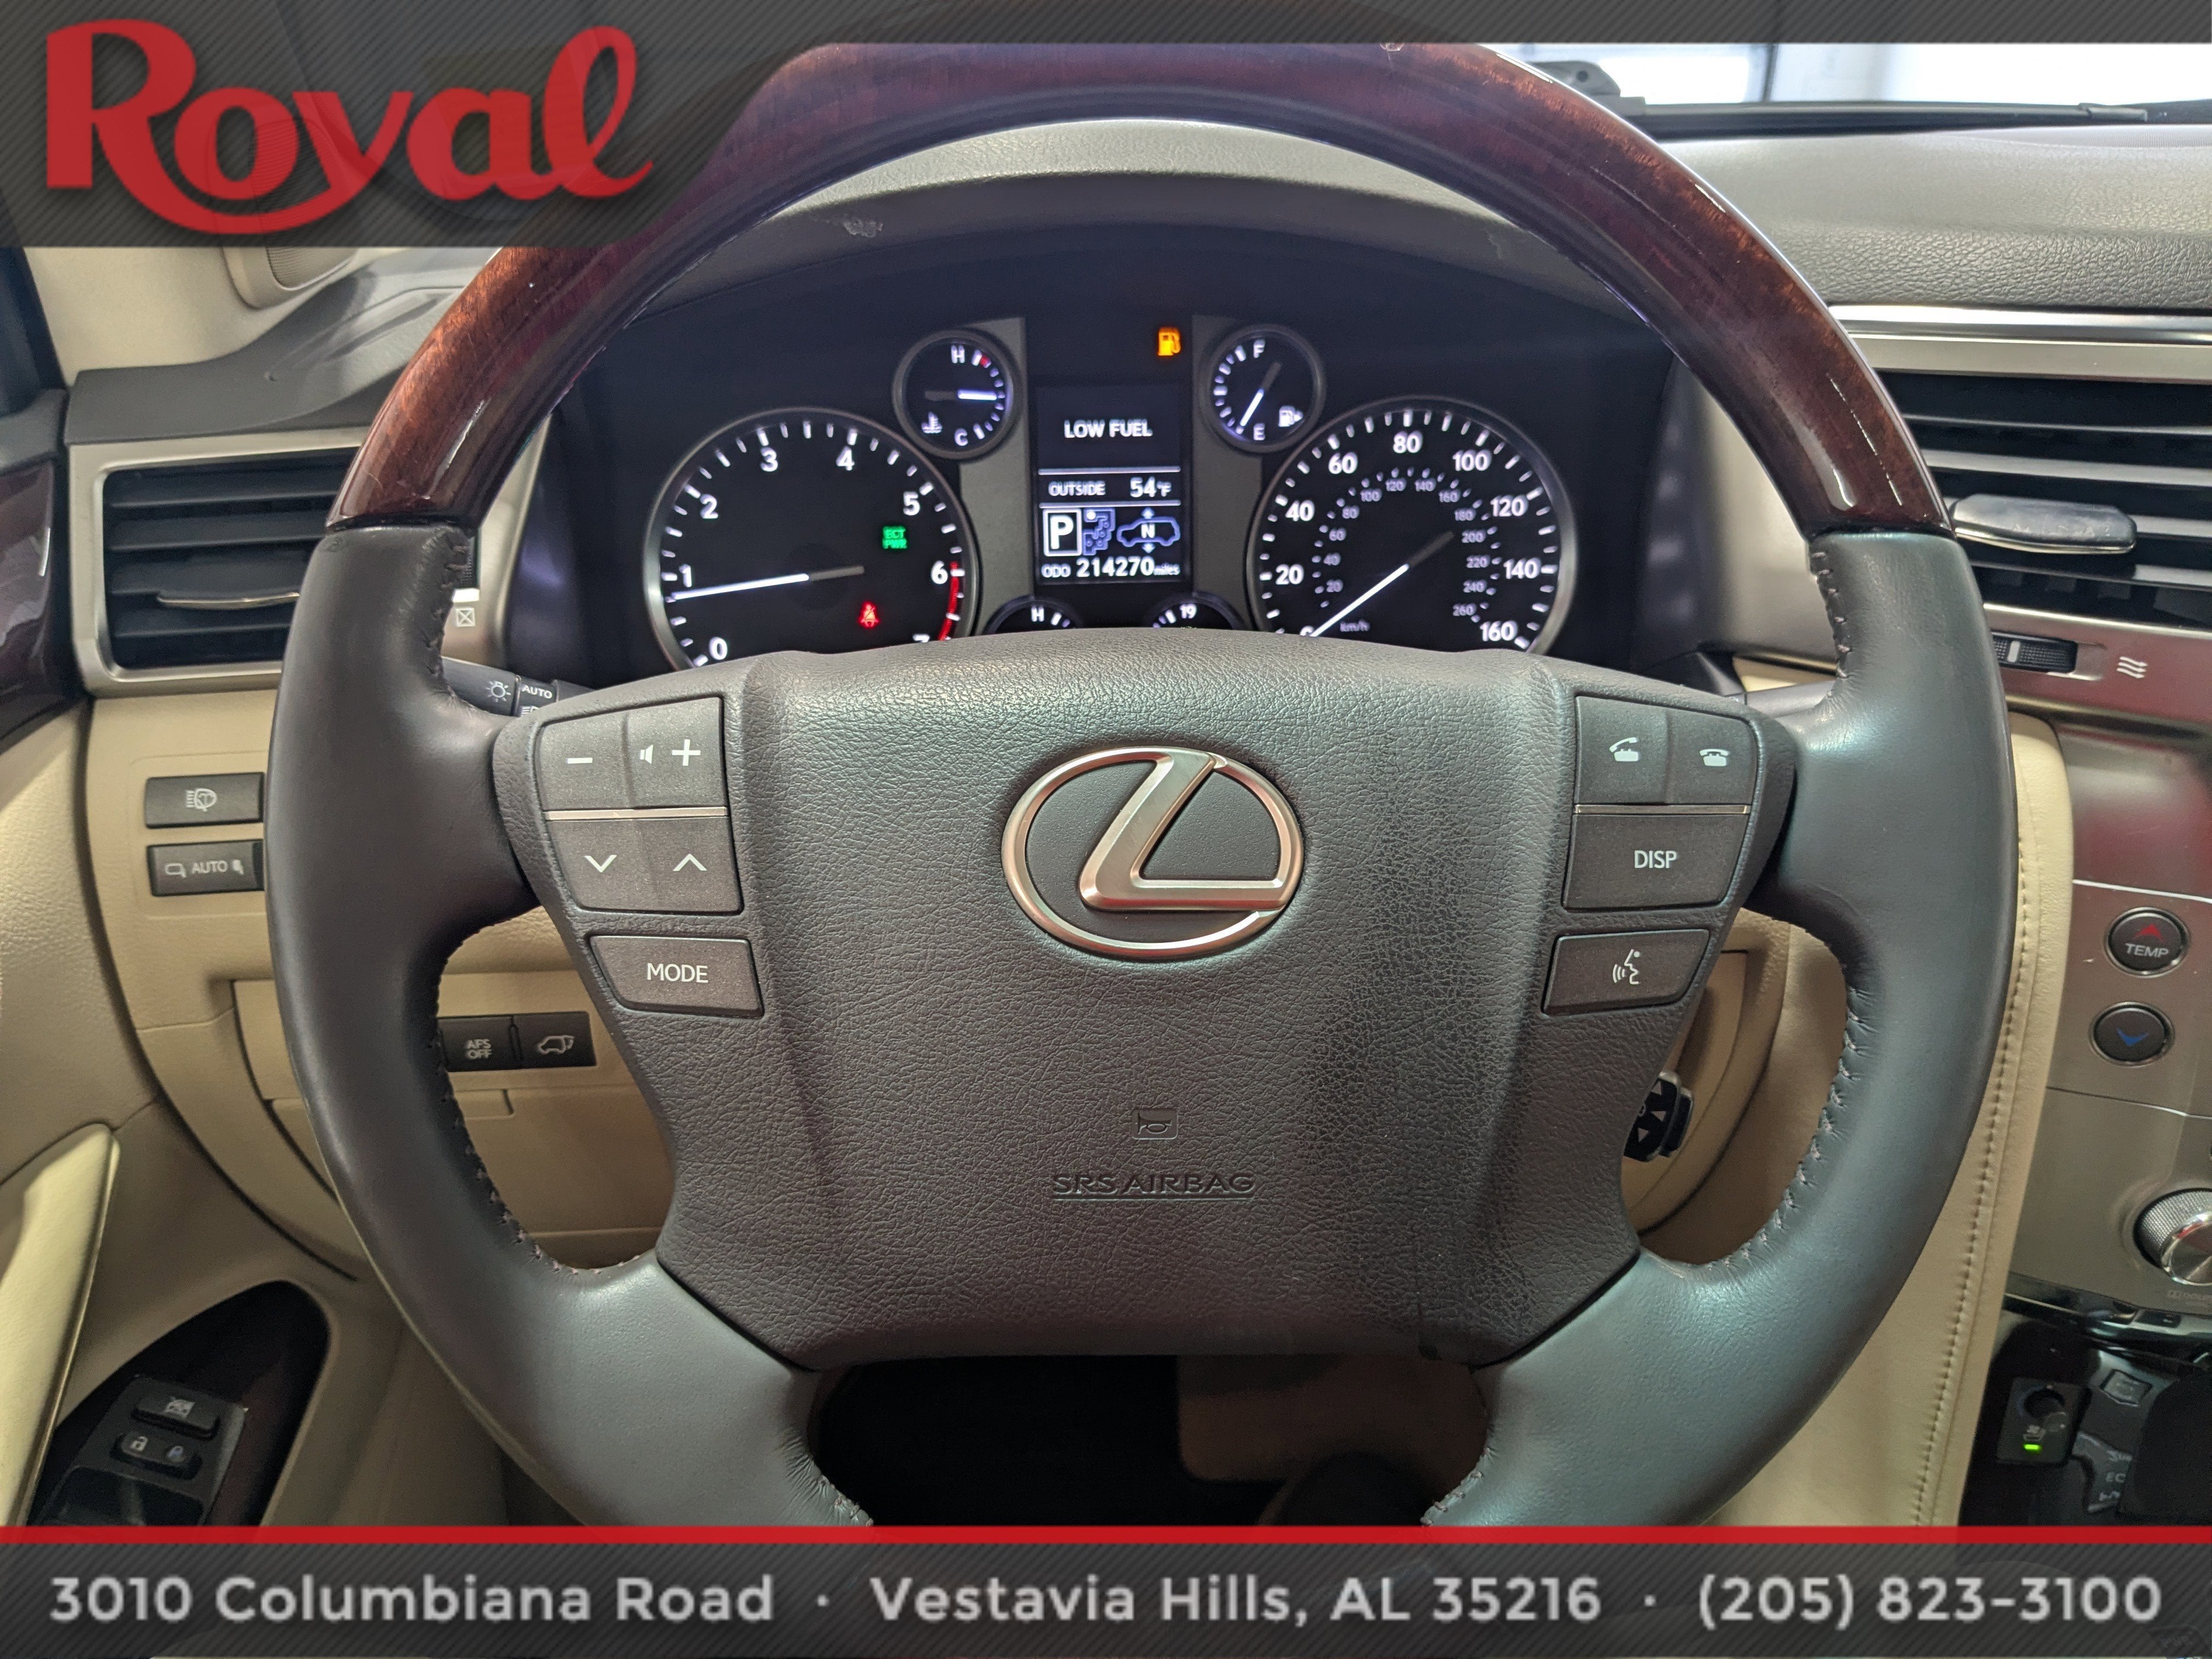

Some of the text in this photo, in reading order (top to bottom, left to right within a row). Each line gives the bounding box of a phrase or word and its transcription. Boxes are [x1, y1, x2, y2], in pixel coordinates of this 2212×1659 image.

[951, 345, 965, 363] H
[1253, 340, 1265, 358] F
[955, 428, 968, 446] C
[1064, 419, 1153, 438] LOW FUEL
[1253, 423, 1265, 441] E
[1393, 431, 1423, 453] 80
[760, 447, 778, 472] 3
[836, 446, 855, 471] 4
[1328, 452, 1358, 474] 60
[1452, 450, 1491, 471] 100
[1048, 481, 1105, 496] OUTSIDE
[1385, 478, 1406, 492] 120
[1414, 478, 1436, 492] 140
[903, 491, 920, 516] 5
[1360, 489, 1382, 502] 100
[1438, 489, 1460, 503] 160
[701, 494, 719, 518] 2
[1285, 500, 1314, 521] 40
[1342, 506, 1359, 519] 80
[1491, 495, 1526, 517] 120
[1454, 510, 1475, 521] 180
[1049, 515, 1074, 549] P
[1141, 522, 1156, 539] N
[1329, 528, 1346, 541] 60
[1462, 530, 1485, 543] 200
[1041, 563, 1071, 578] ODO
[1075, 554, 1154, 577] 214270
[1323, 554, 1340, 566] 40
[1466, 555, 1490, 568] 220
[1503, 557, 1541, 579] 140
[679, 564, 692, 588] 1
[931, 561, 948, 584] 6
[1276, 564, 1304, 585] 20
[1327, 580, 1343, 592] 20
[1463, 580, 1486, 592] 240
[1031, 606, 1044, 622] H
[1180, 602, 1197, 619] 19
[1453, 603, 1475, 616] 260
[1480, 620, 1517, 641] 160
[708, 637, 727, 660] 0
[522, 684, 552, 699] AUTO
[192, 860, 228, 874] AUTO
[1635, 850, 1677, 868] DISP
[2124, 943, 2170, 958] TEMP
[647, 963, 708, 983] MODE
[466, 1049, 493, 1060] OFF
[1053, 1173, 1256, 1195] SRS AIRBAG
